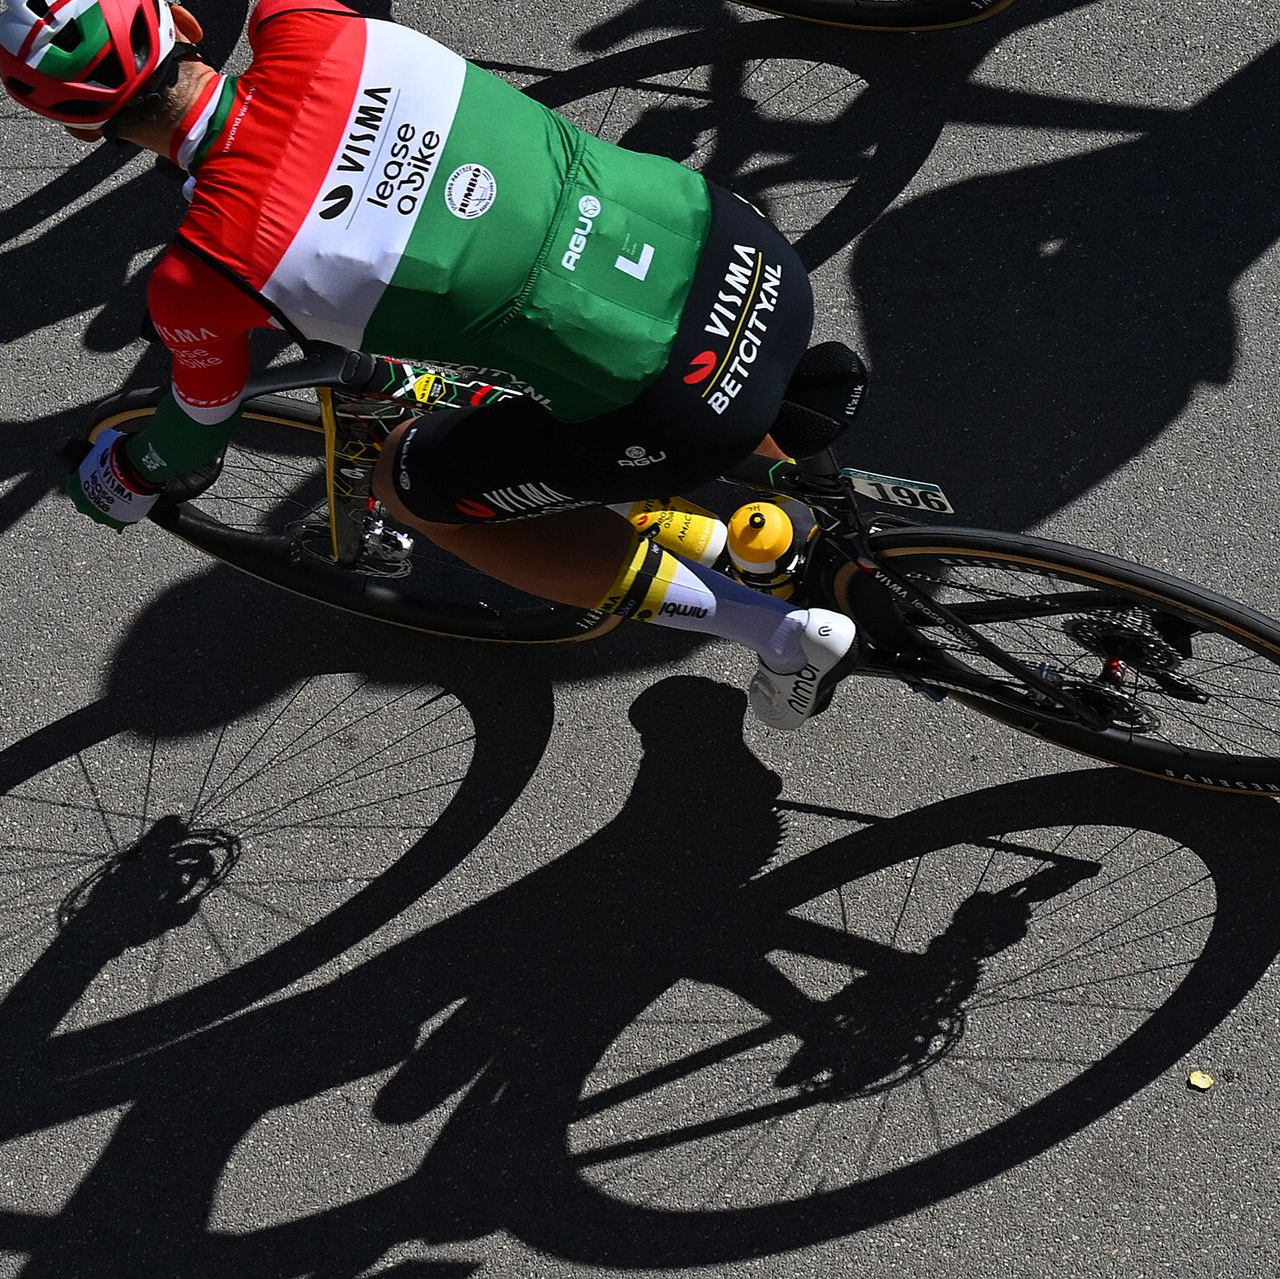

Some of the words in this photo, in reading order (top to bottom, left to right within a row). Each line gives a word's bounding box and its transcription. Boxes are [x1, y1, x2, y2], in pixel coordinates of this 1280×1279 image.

[336, 87, 392, 173] VISMA
[366, 122, 416, 209] lease
[458, 167, 482, 215] JUMBO
[561, 216, 593, 271] AGU
[704, 243, 756, 338] VISMA
[706, 263, 782, 415] BETCITY.NL
[617, 450, 667, 468] AGU
[101, 467, 134, 502] VISMA
[482, 481, 574, 513] VISMA
[868, 482, 947, 513] 196
[874, 570, 908, 599] VISMA
[658, 601, 708, 620] nimbl
[786, 663, 821, 716] nimbl
